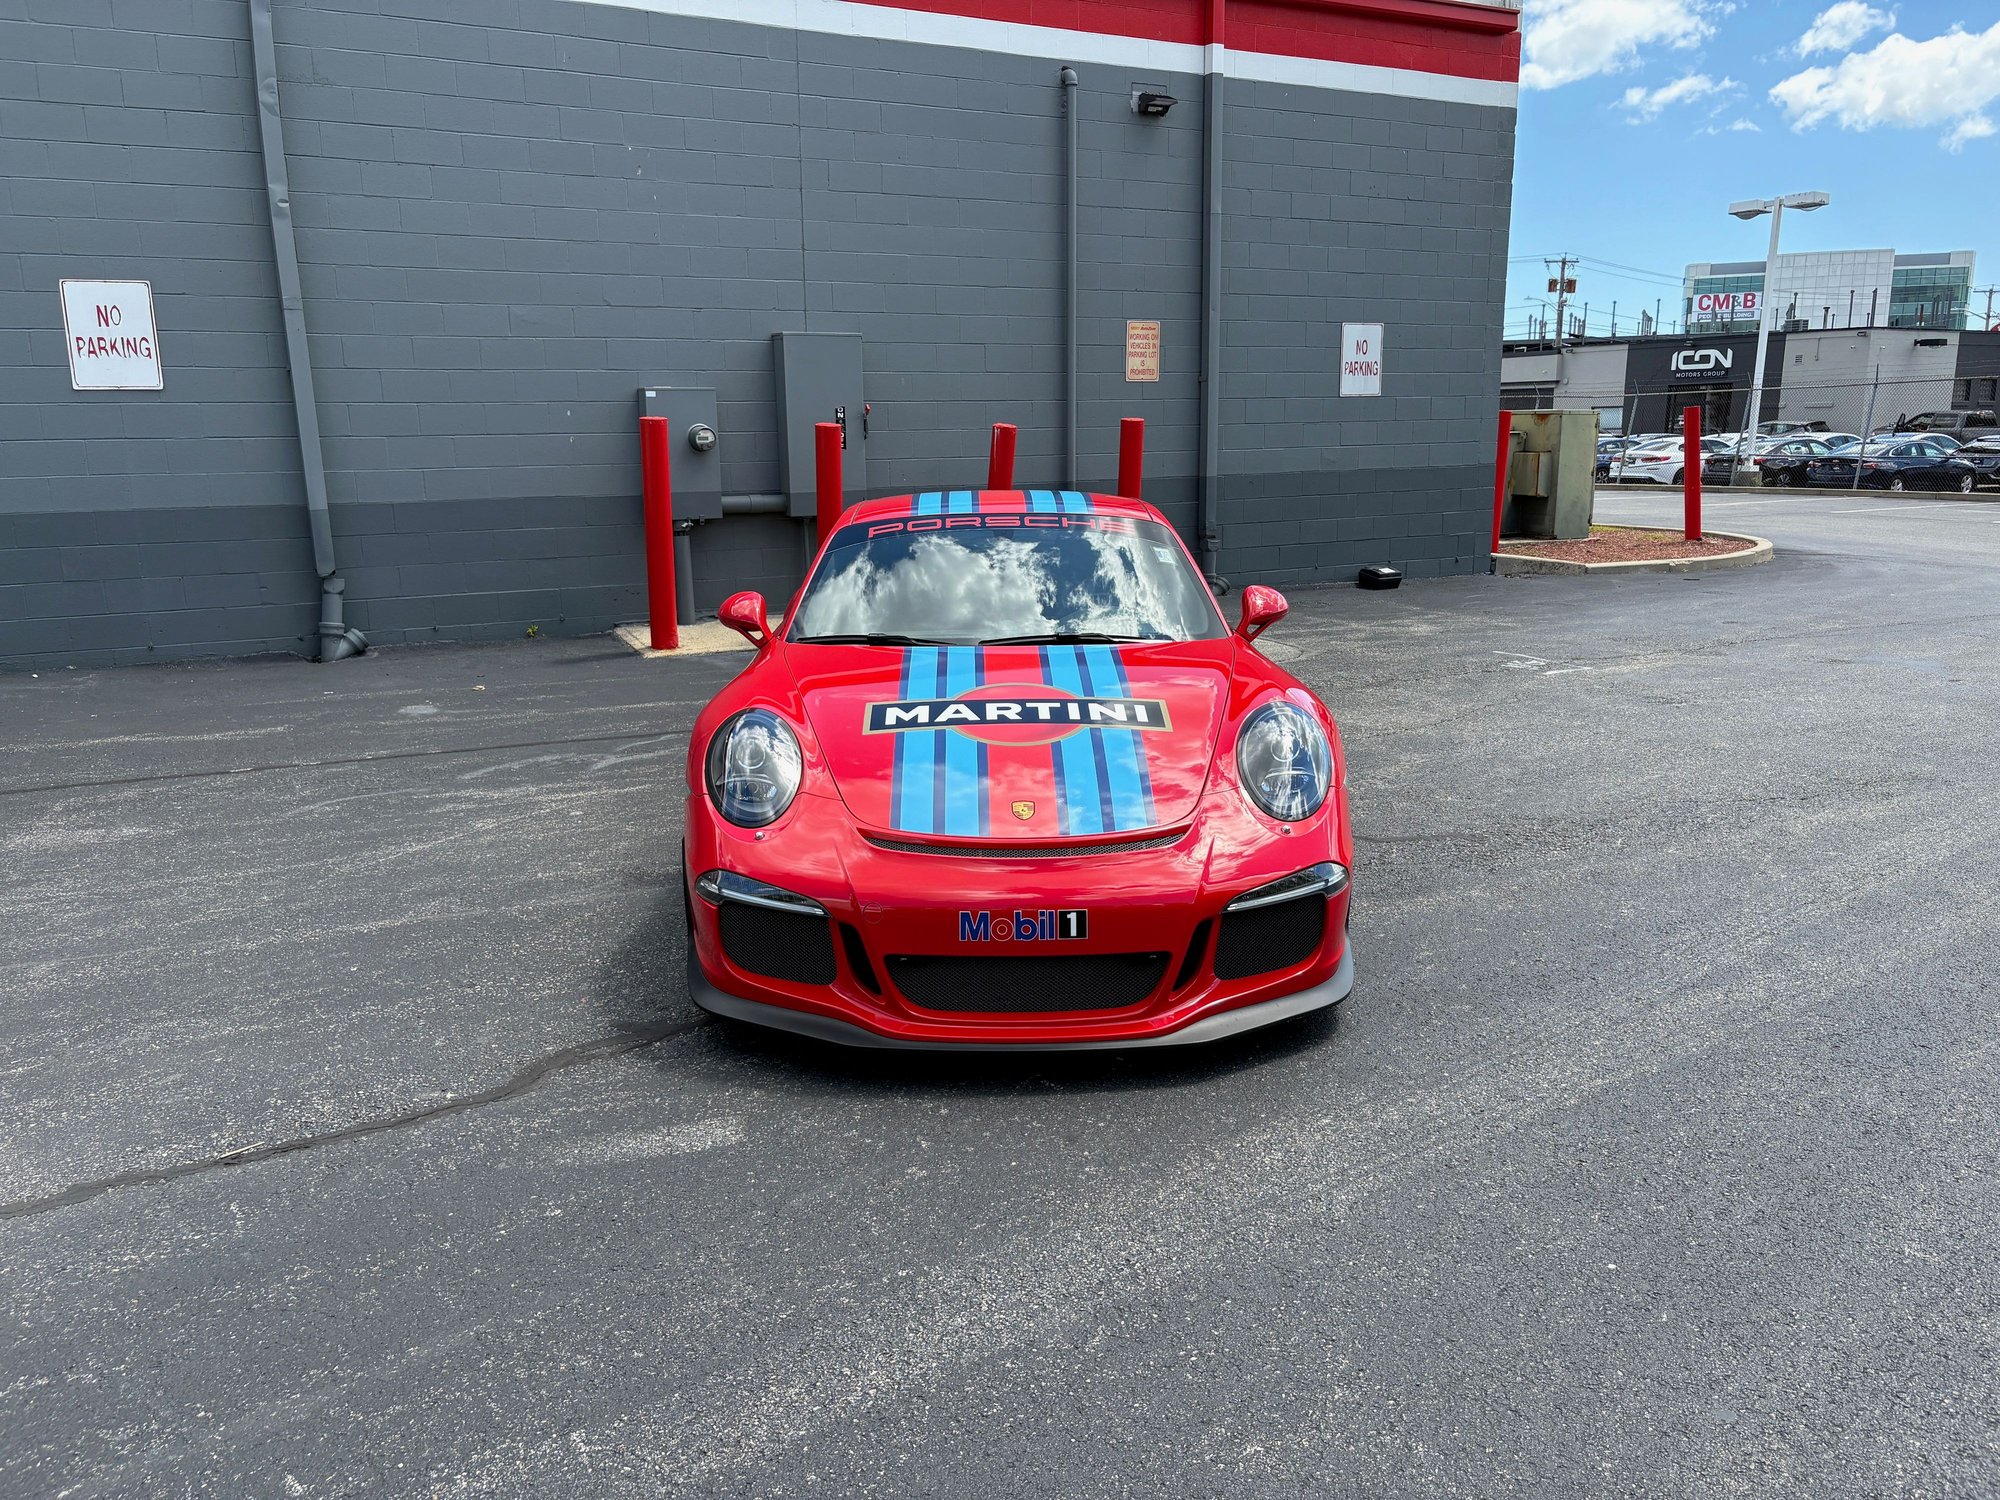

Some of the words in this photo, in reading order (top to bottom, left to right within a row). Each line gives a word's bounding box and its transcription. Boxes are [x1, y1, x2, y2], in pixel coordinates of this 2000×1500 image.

[1698, 292, 1756, 311] CM&B
[95, 305, 122, 328] NO
[75, 336, 152, 359] PARKING
[1355, 339, 1368, 355] NO
[1344, 361, 1379, 376] PARKING
[1670, 348, 1733, 371] ICON
[868, 516, 1135, 539] PORSCHE
[885, 702, 1149, 725] MARTINI
[959, 910, 1056, 942] Mobil
